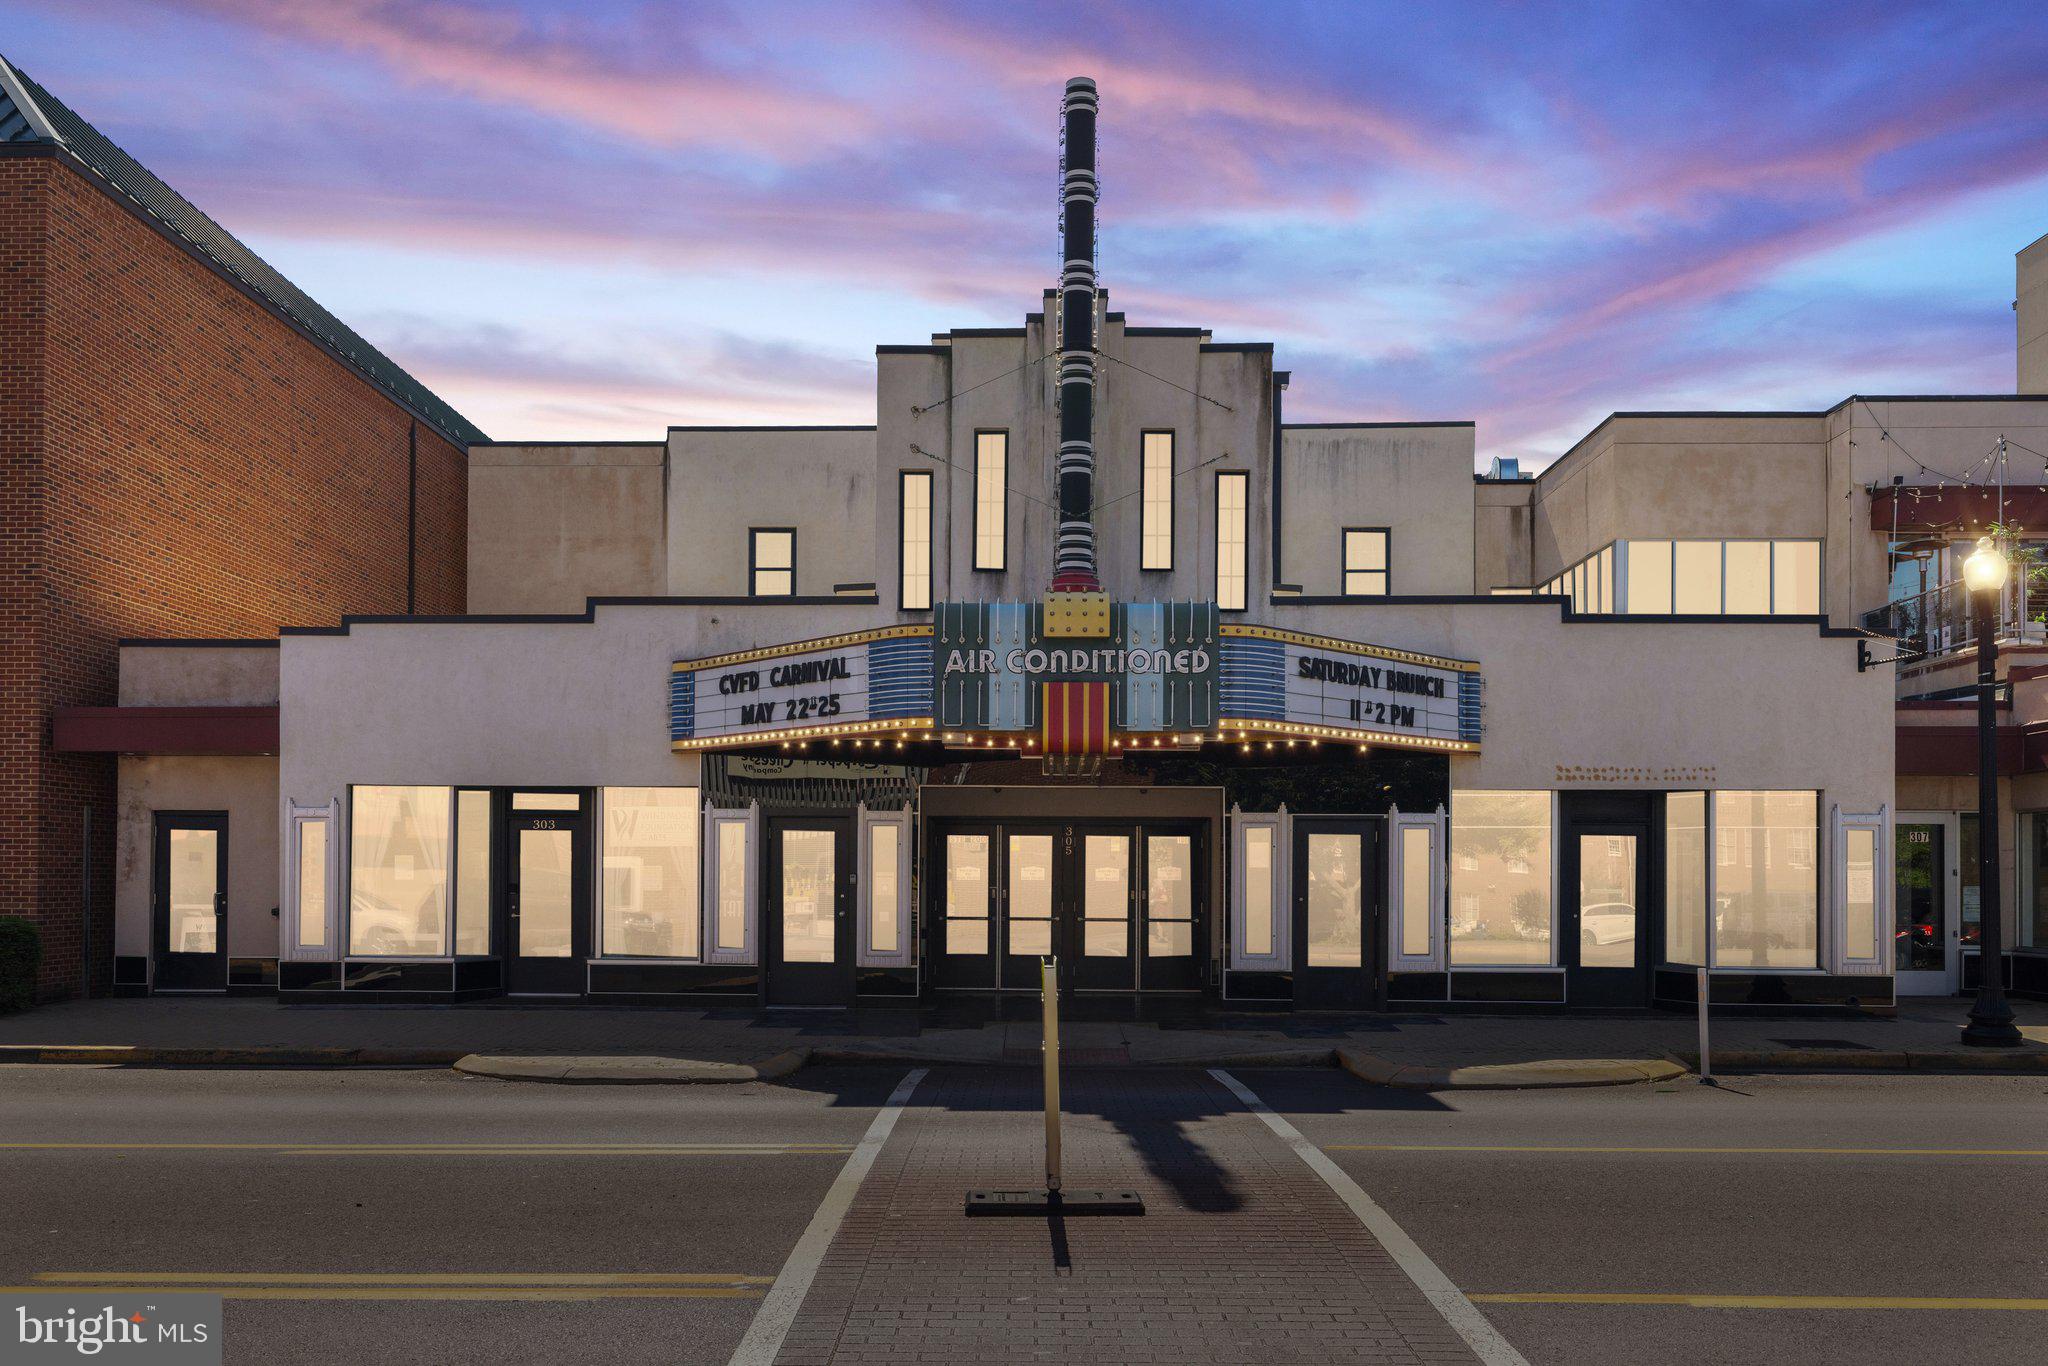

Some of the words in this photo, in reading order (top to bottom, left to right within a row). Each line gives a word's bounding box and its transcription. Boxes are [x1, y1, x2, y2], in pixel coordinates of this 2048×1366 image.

[946, 649, 996, 673] AIR
[1006, 648, 1211, 674] CONDITIONED
[719, 671, 759, 695] CVFD
[769, 657, 850, 687] CARNIVAL
[1299, 656, 1381, 688] SATURDAY
[1387, 670, 1444, 698] BRUNCH
[741, 702, 776, 725] MAY
[1391, 704, 1414, 727] PM
[533, 820, 556, 830] 303
[1910, 832, 1929, 842] 307
[1065, 826, 1073, 855] 305
